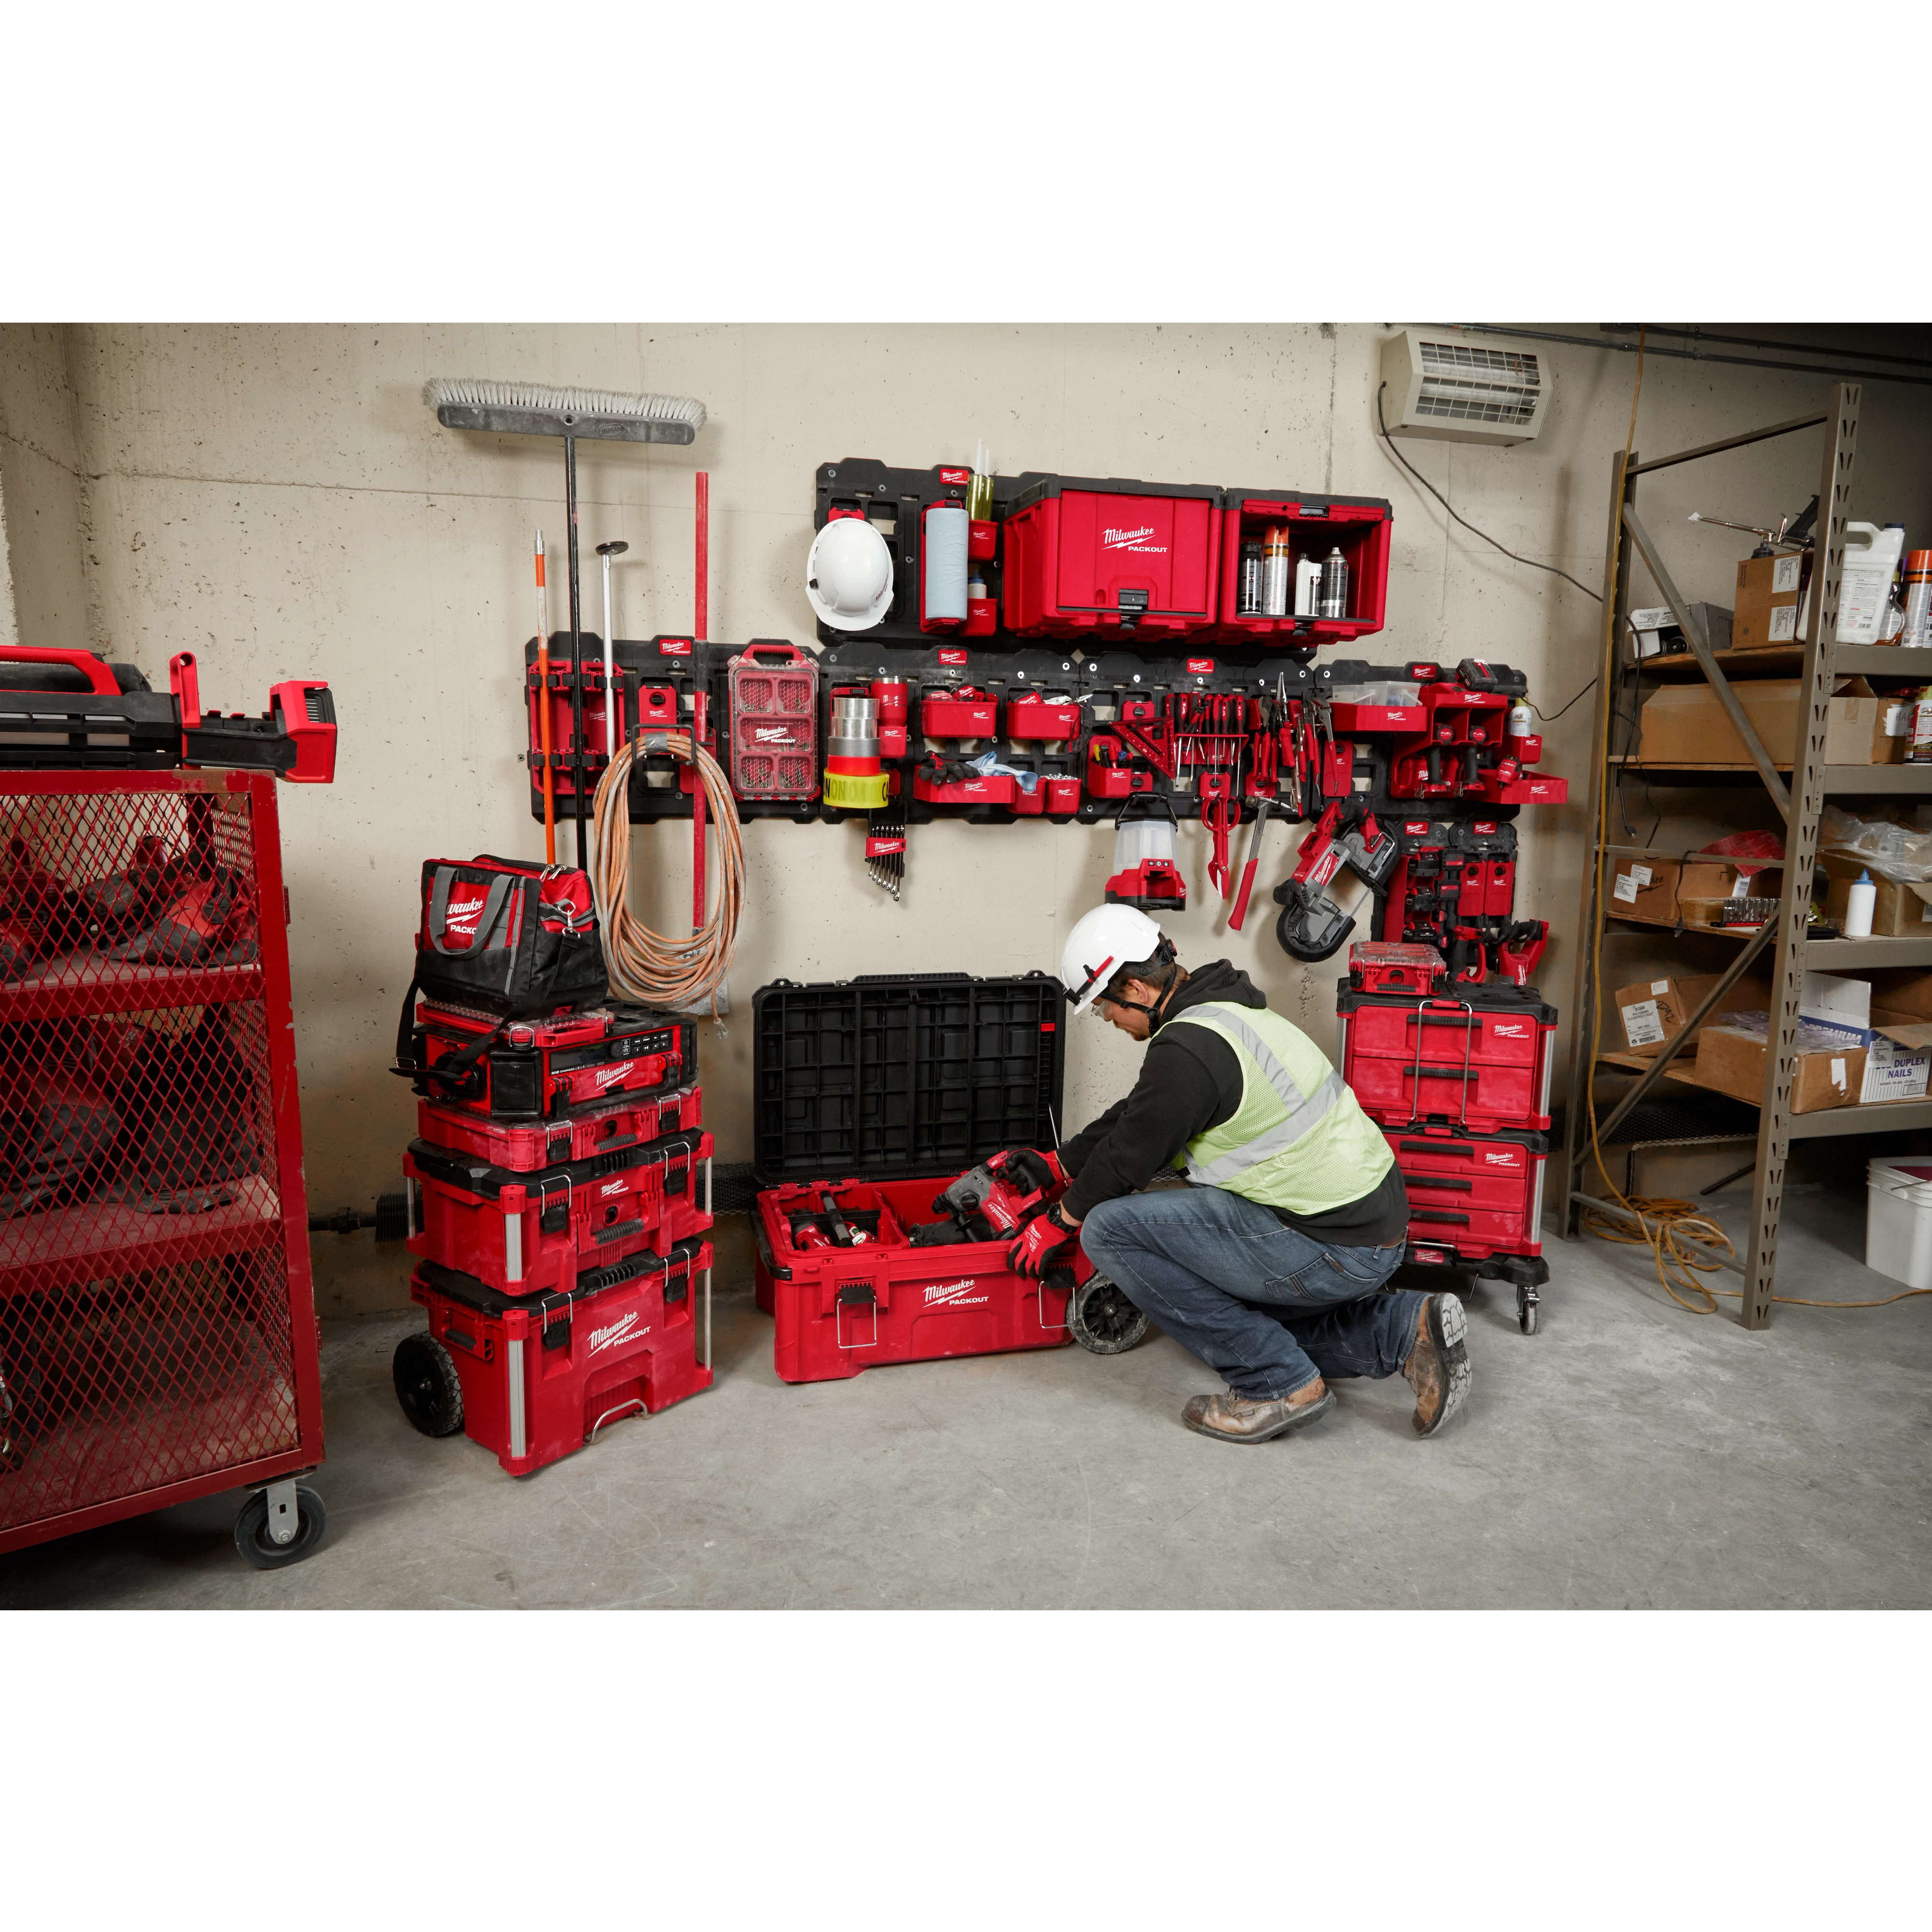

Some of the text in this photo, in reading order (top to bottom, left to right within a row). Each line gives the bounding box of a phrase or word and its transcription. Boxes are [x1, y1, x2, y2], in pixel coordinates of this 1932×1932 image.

[1102, 526, 1155, 545] Milwaukee
[662, 642, 684, 651] Milwaukee
[941, 652, 960, 660] Milwaukee
[754, 726, 788, 739] Milwaukee
[874, 841, 900, 851] Milwaukee
[1314, 855, 1331, 883] Milwaukee
[445, 898, 483, 915] waukee
[1494, 1024, 1522, 1033] Milwaukee
[1894, 1056, 1925, 1068] DUPLEX
[595, 1062, 635, 1086] Milwaukee
[1888, 1068, 1912, 1079] NAILS
[1485, 1153, 1514, 1161] Milwaukee
[600, 1179, 624, 1195] Milwaukee
[612, 1186, 629, 1195] PACKOUT
[997, 1193, 1006, 1208] FUEL
[988, 1203, 1014, 1229] Milwaukee
[922, 1279, 976, 1303] Milwaukee
[949, 1296, 989, 1306] PACKOUT
[587, 1310, 639, 1350] Milwaukee
[613, 1326, 651, 1347] PACKOUT
